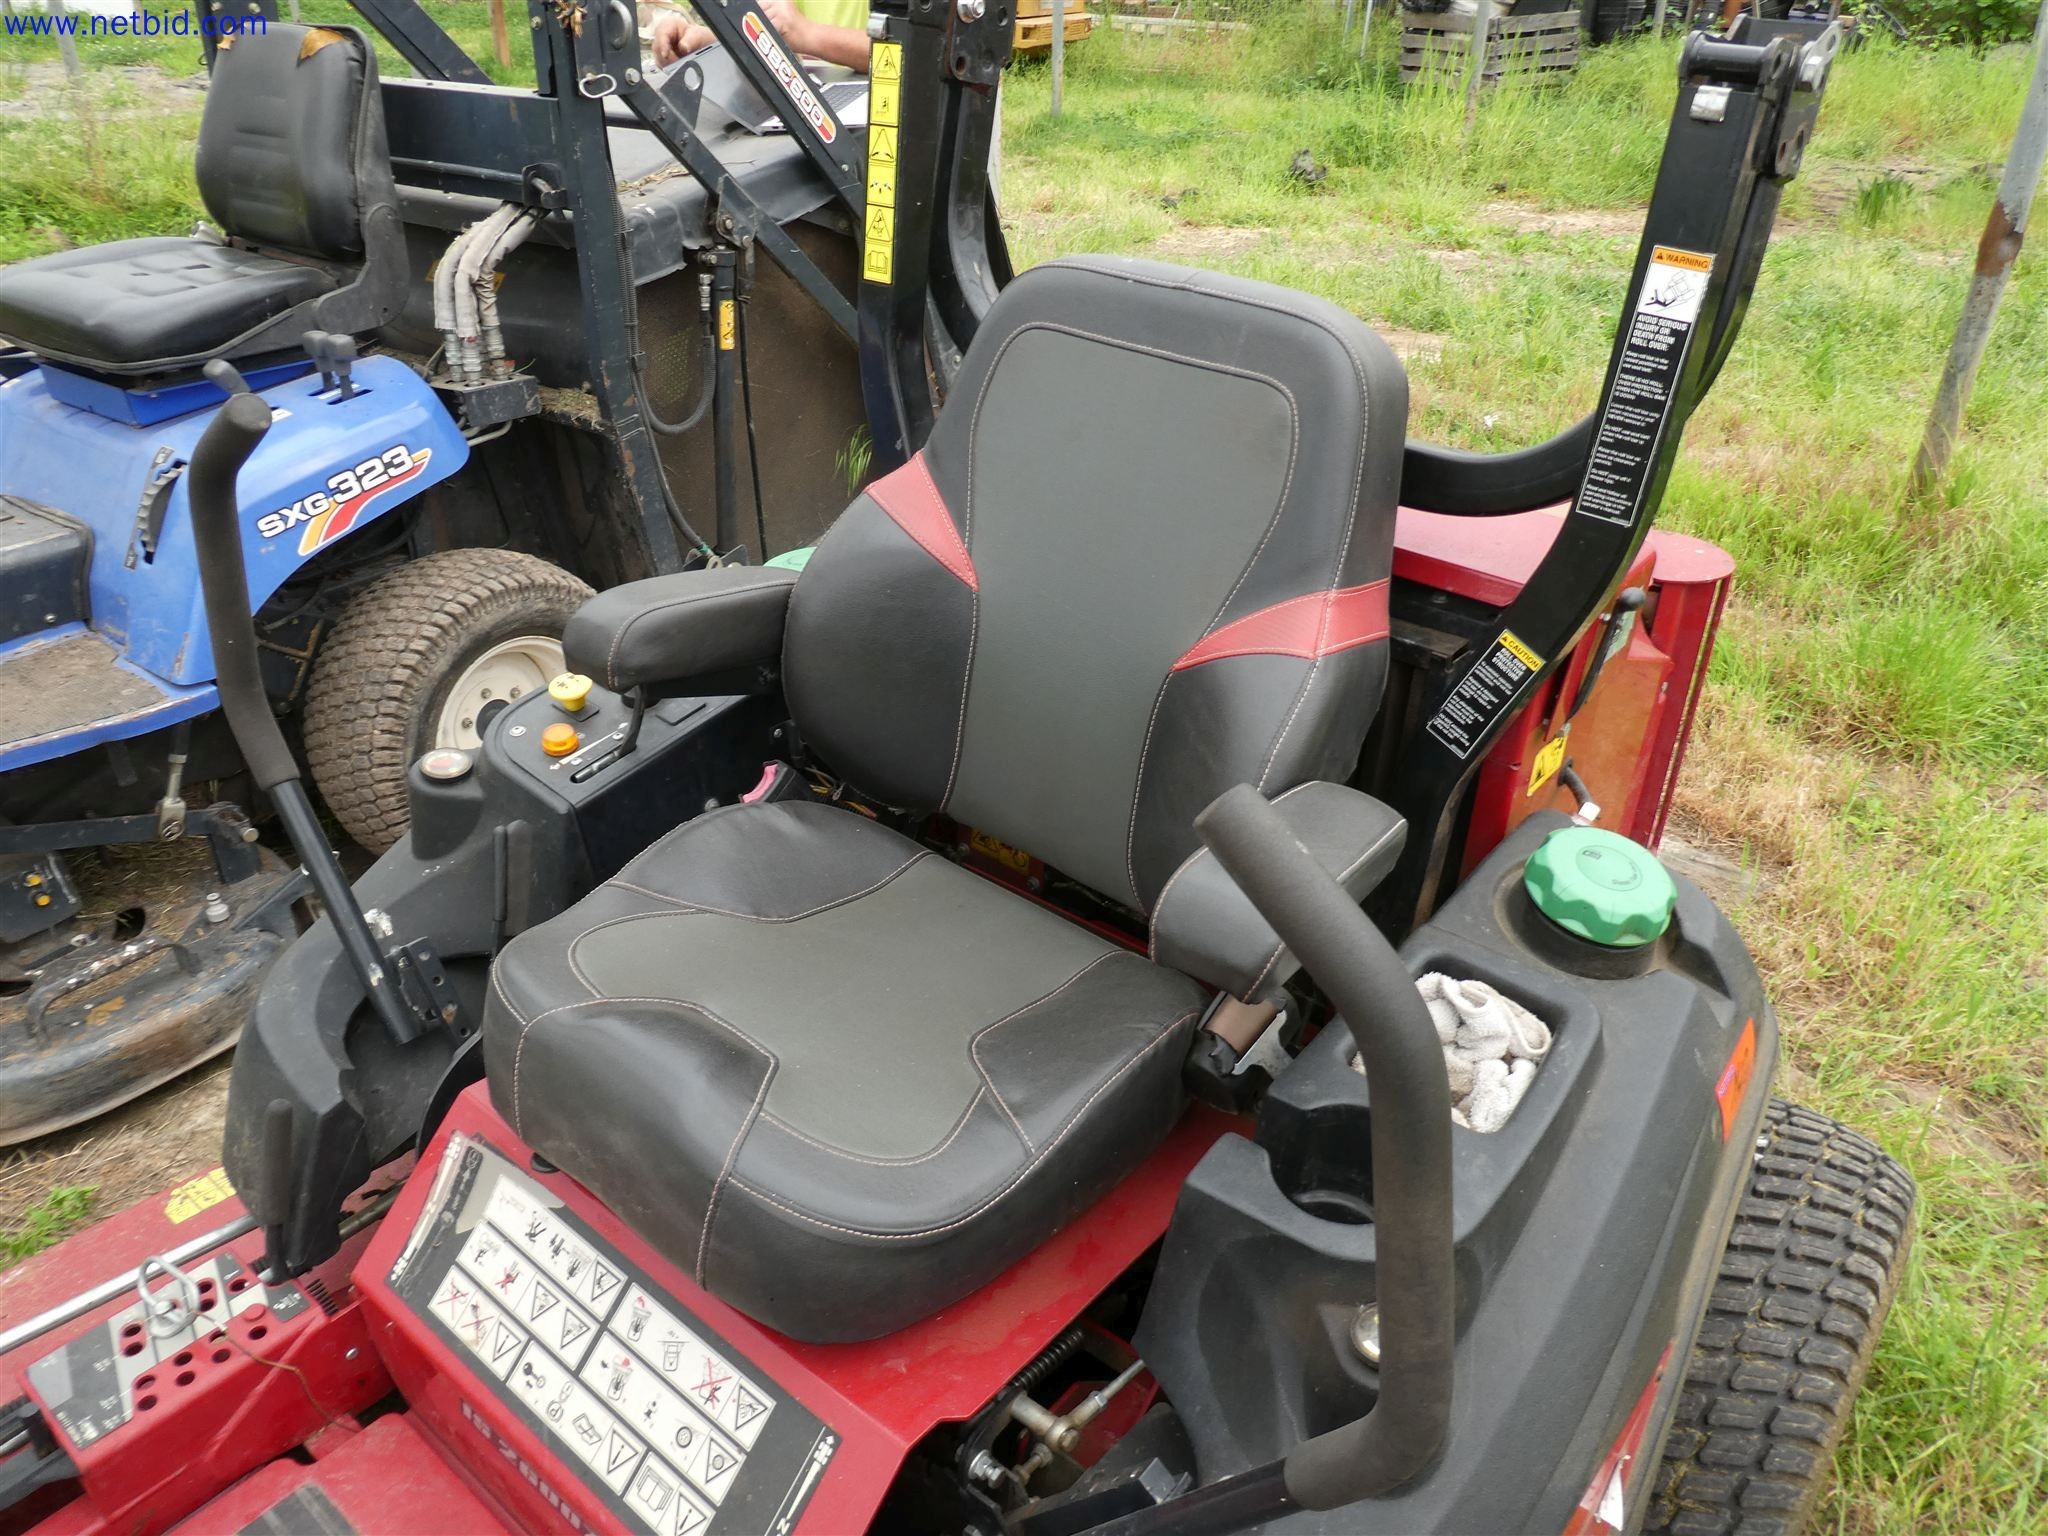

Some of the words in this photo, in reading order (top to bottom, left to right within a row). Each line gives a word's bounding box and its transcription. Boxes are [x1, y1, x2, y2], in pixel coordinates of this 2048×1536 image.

[1665, 253, 1709, 268] WARNING
[1635, 321, 1659, 333] INJURY
[1659, 326, 1671, 335] OR
[1637, 313, 1658, 324] AVOID
[1658, 317, 1688, 331] SERIOUS
[1630, 336, 1649, 347] ROLL
[1632, 328, 1655, 340] DEATH
[1654, 333, 1676, 345] FROM
[256, 491, 331, 539] SXG
[326, 443, 415, 504] 323
[1508, 640, 1539, 667] CAUTION
